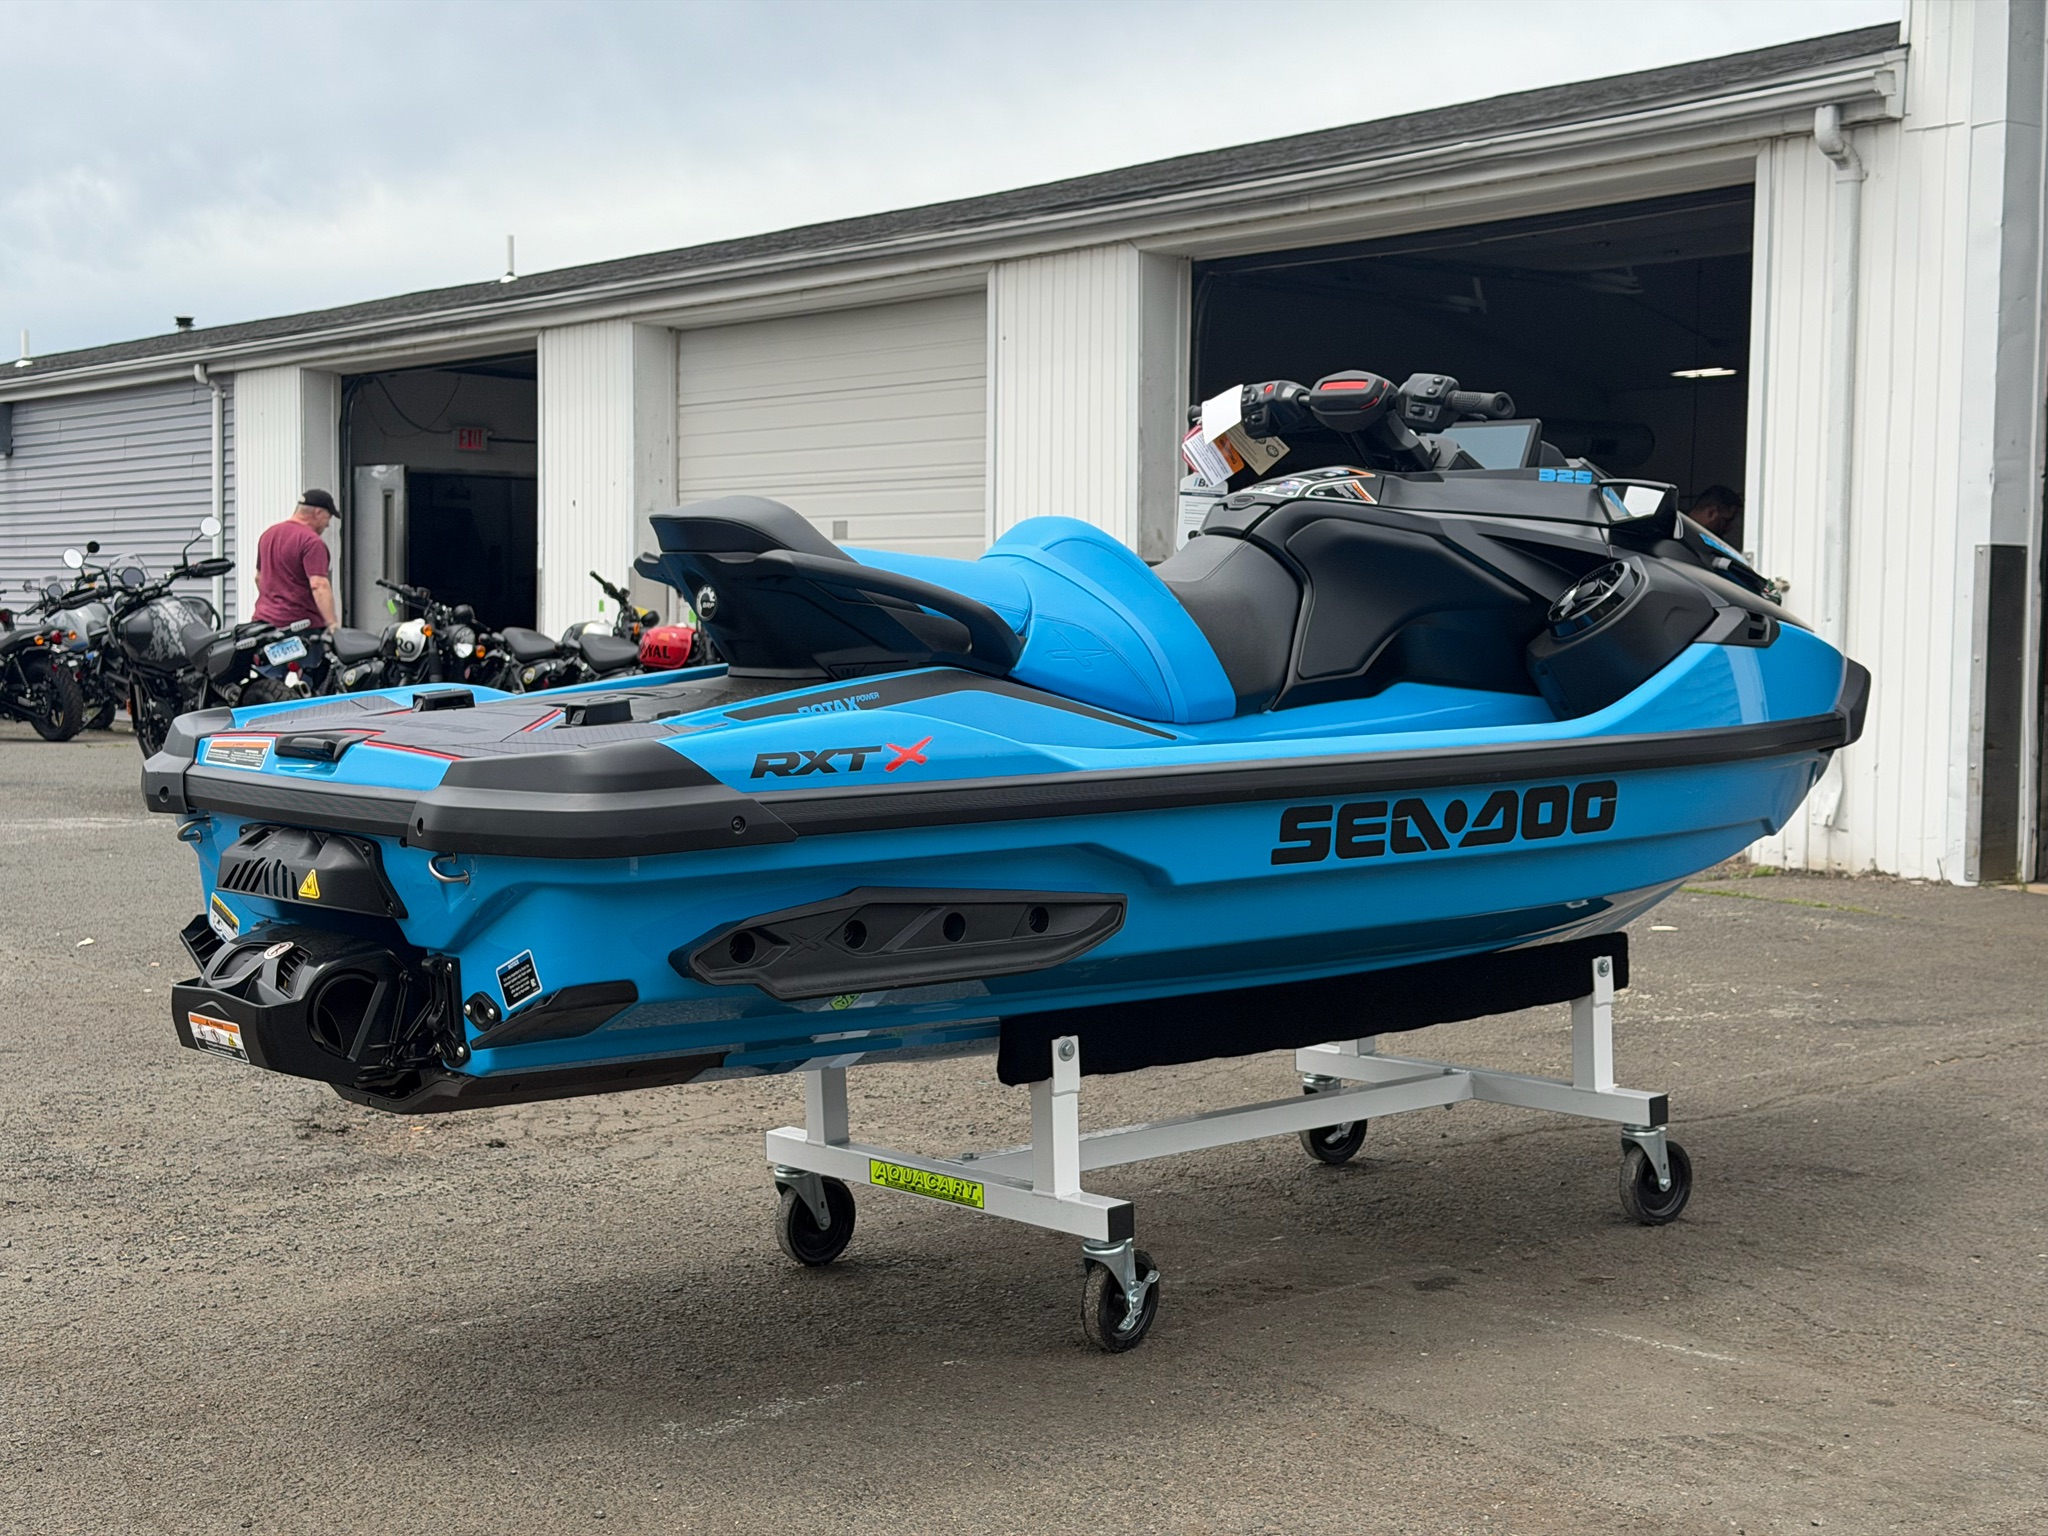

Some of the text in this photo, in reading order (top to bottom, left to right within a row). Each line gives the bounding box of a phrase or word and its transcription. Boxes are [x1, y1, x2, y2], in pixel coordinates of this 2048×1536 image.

[459, 427, 484, 449] EXIT
[1538, 468, 1593, 484] 325
[855, 691, 881, 704] POWER
[750, 746, 882, 779] RXT
[875, 1163, 977, 1198] AQUACART
